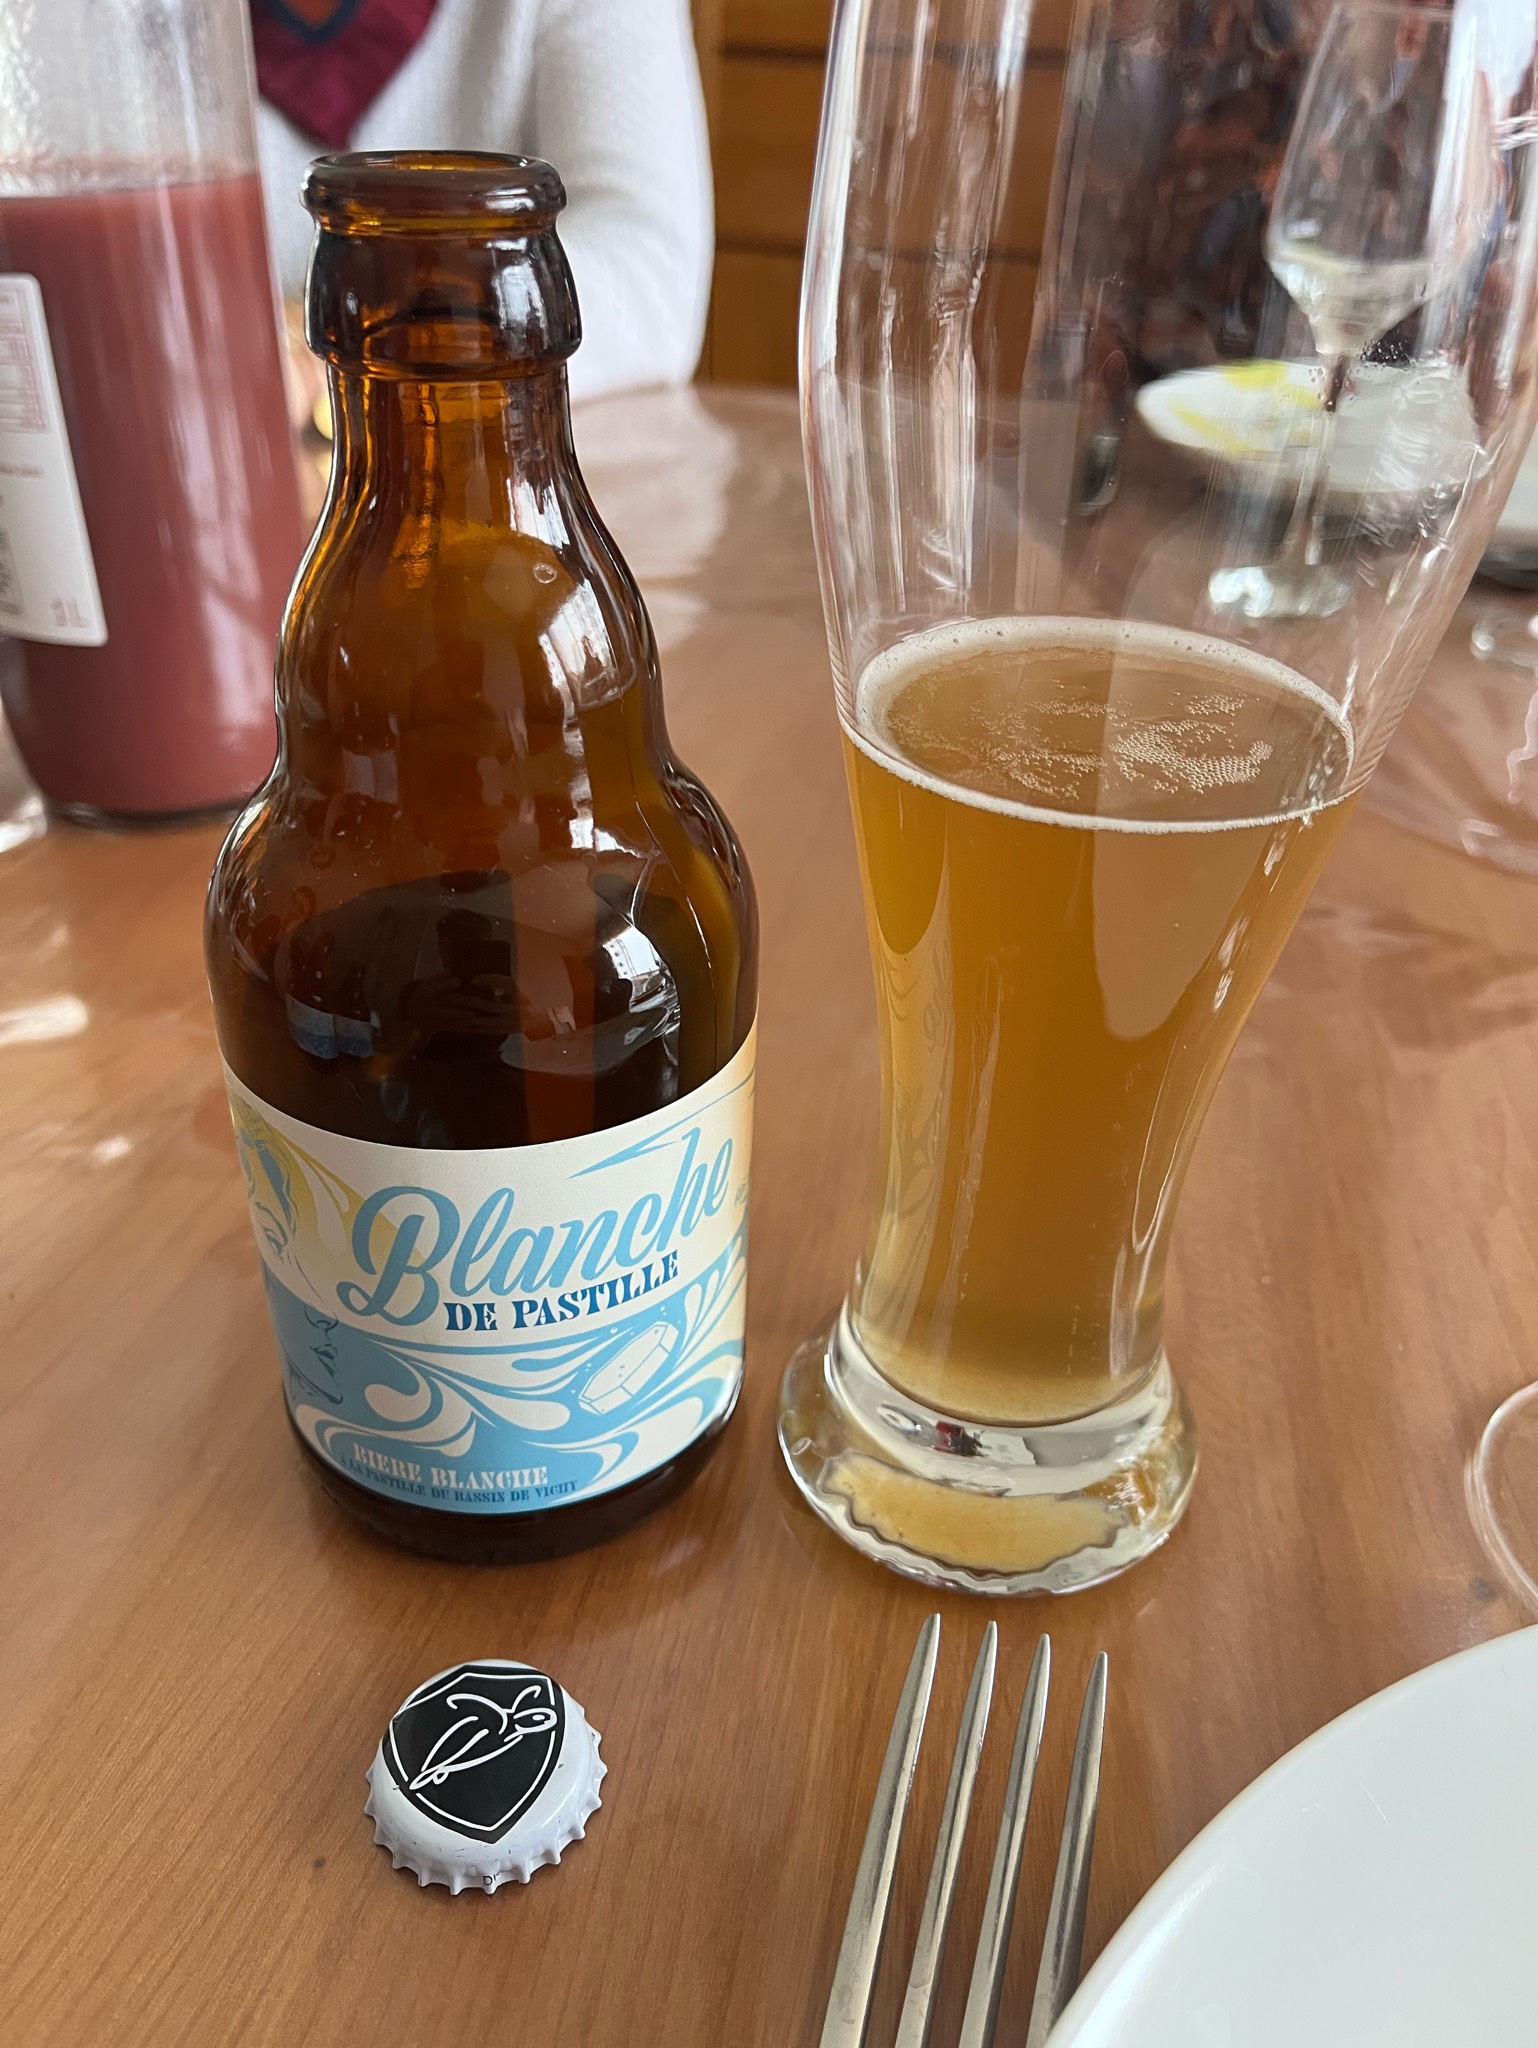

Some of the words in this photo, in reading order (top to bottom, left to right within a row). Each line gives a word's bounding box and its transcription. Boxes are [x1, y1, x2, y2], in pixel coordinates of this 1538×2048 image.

[338, 1126, 734, 1326] Blanche
[445, 1301, 498, 1331] DE
[512, 1249, 679, 1328] PASTILLE
[349, 1458, 363, 1474] LA
[366, 1467, 427, 1496] PASTILLE
[430, 1487, 450, 1499] DU
[455, 1491, 505, 1503] BASSIN
[511, 1489, 530, 1501] DE
[534, 1480, 579, 1499] VICHY
[430, 1466, 549, 1490] BLANCHE
